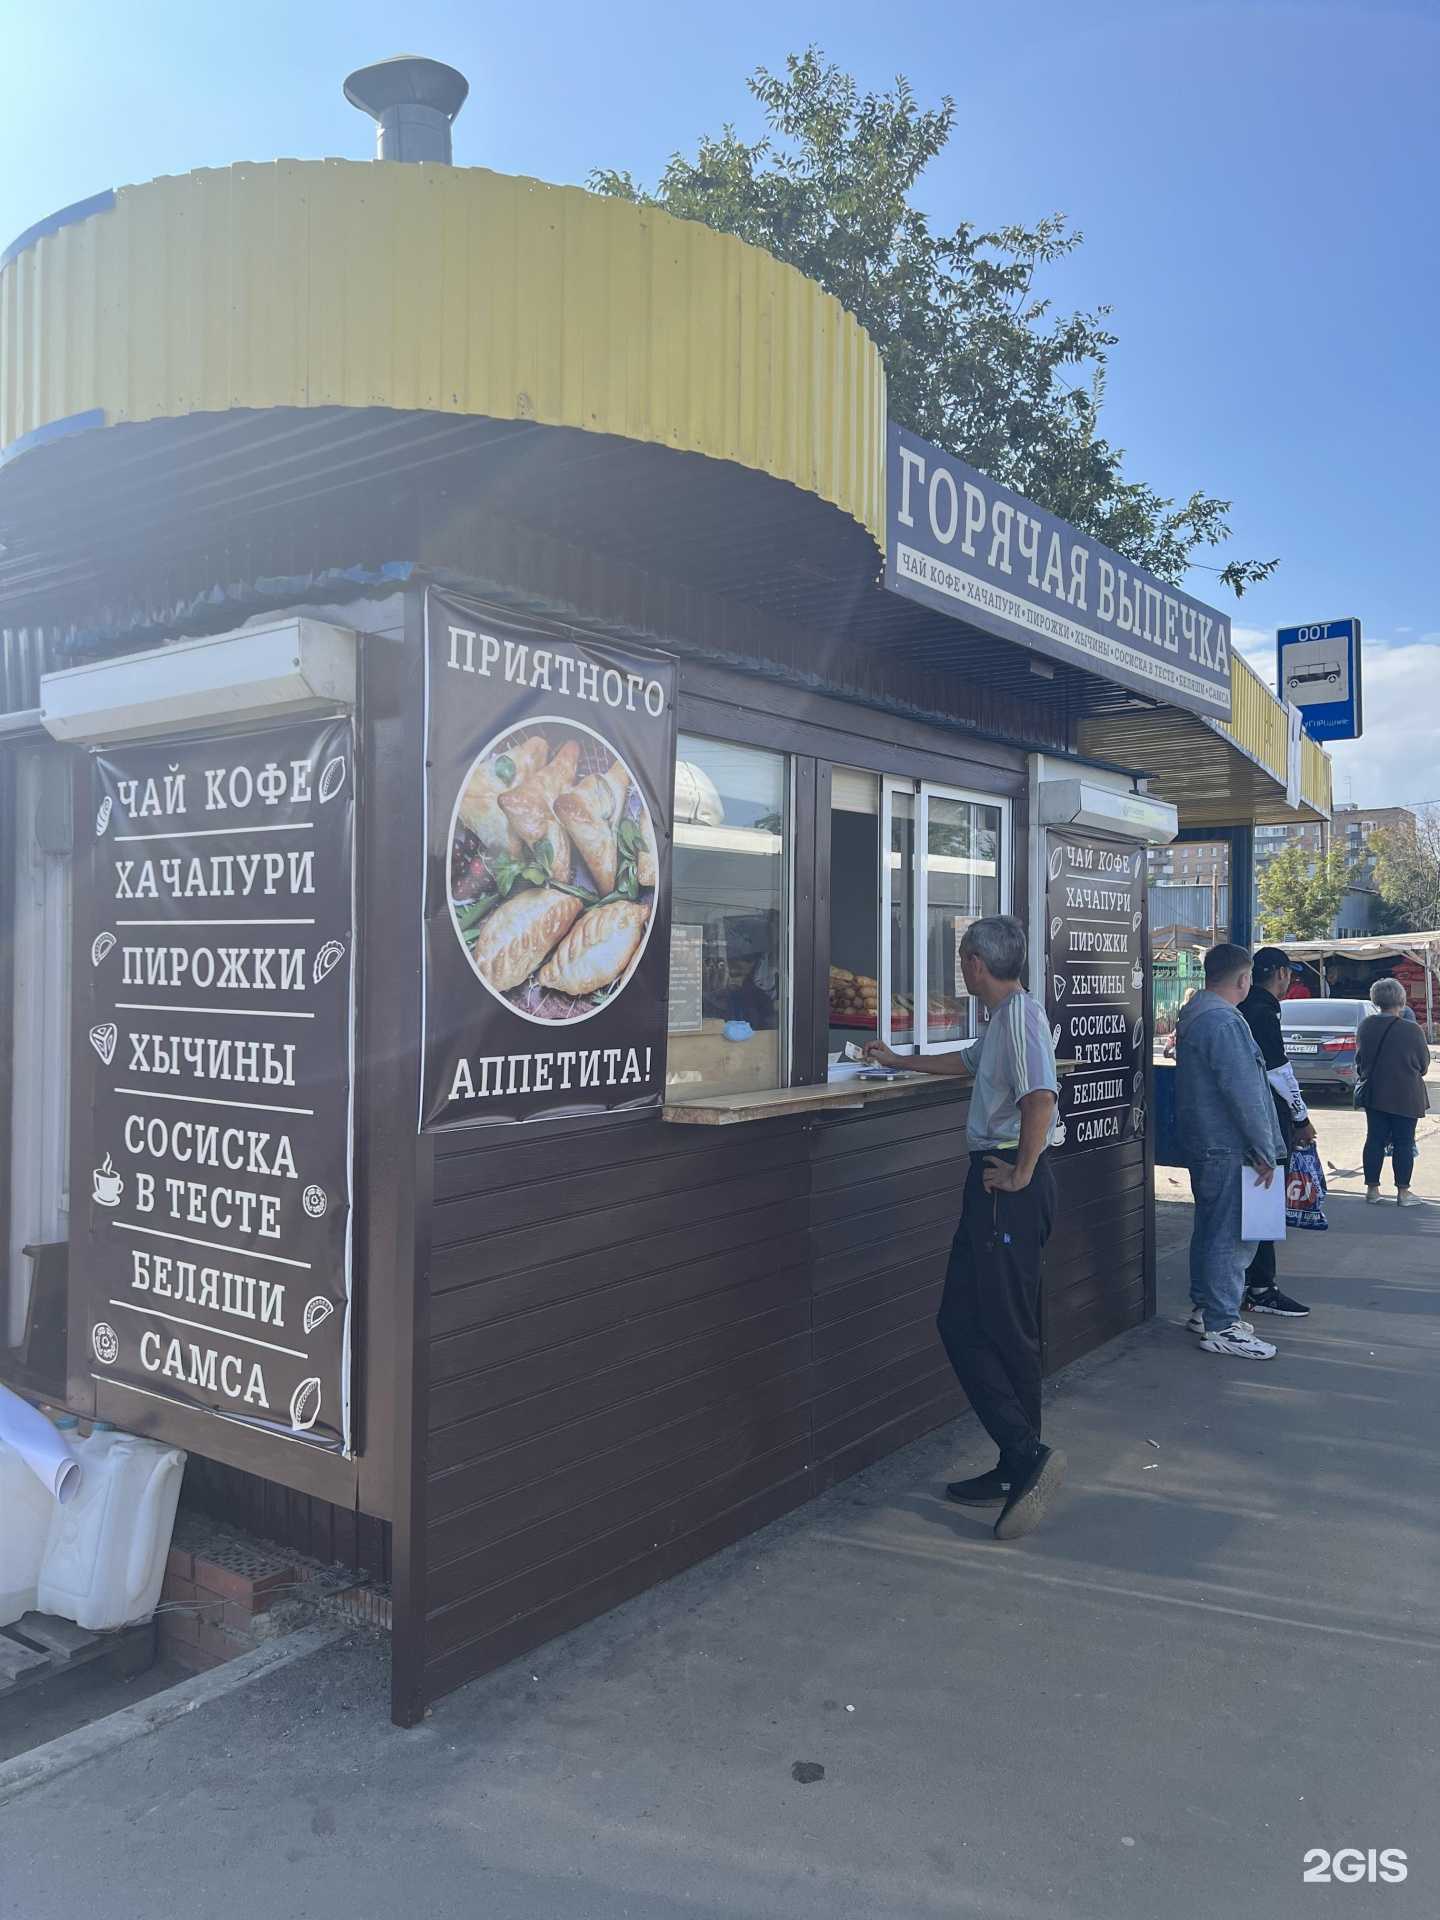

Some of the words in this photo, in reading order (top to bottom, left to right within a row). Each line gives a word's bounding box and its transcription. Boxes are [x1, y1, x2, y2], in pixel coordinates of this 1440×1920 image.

[898, 445, 1089, 611] ГОРЯЧАЯ
[1097, 557, 1230, 676] ВЫПЕЧКА
[902, 553, 927, 578] ЧАЙ
[930, 566, 961, 592] КОФЕ
[967, 582, 1021, 618] ХАЧАПУРИ
[1027, 608, 1070, 639] ПИРОЖКИ
[1074, 630, 1110, 657] ХЫЧИНЫ
[1114, 648, 1148, 673] СОСИСКА
[446, 625, 665, 717] ПРИЯТНОГО
[117, 763, 187, 818] ЧАЙ
[204, 759, 312, 811] КОФЕ
[115, 851, 316, 899] ХАЧАПУРИ
[1066, 845, 1094, 869] ЧАЙ
[1098, 851, 1130, 874] КОФЕ
[1066, 887, 1131, 912] ХАЧАПУРИ
[1069, 931, 1128, 953] ПИРОЖКИ
[122, 946, 306, 991] ПИРОЖКИ
[1071, 975, 1126, 995] ХЫЧИНЫ
[1070, 1014, 1126, 1037] СОСИСКА
[128, 1033, 296, 1087] ХЫЧИНЫ
[447, 1046, 653, 1100] АППЕТИТА!
[1074, 1045, 1082, 1061] В
[1085, 1041, 1122, 1063] ТЕСТЕ
[1073, 1079, 1124, 1105] БЕЛЯШИ
[124, 1114, 299, 1180] СОСИСКА
[1077, 1116, 1119, 1142] САМСА
[136, 1172, 155, 1213] В
[166, 1177, 281, 1239] ТЕСТЕ
[131, 1250, 286, 1328] БЕЛЯШИ
[139, 1331, 270, 1409] САМСА
